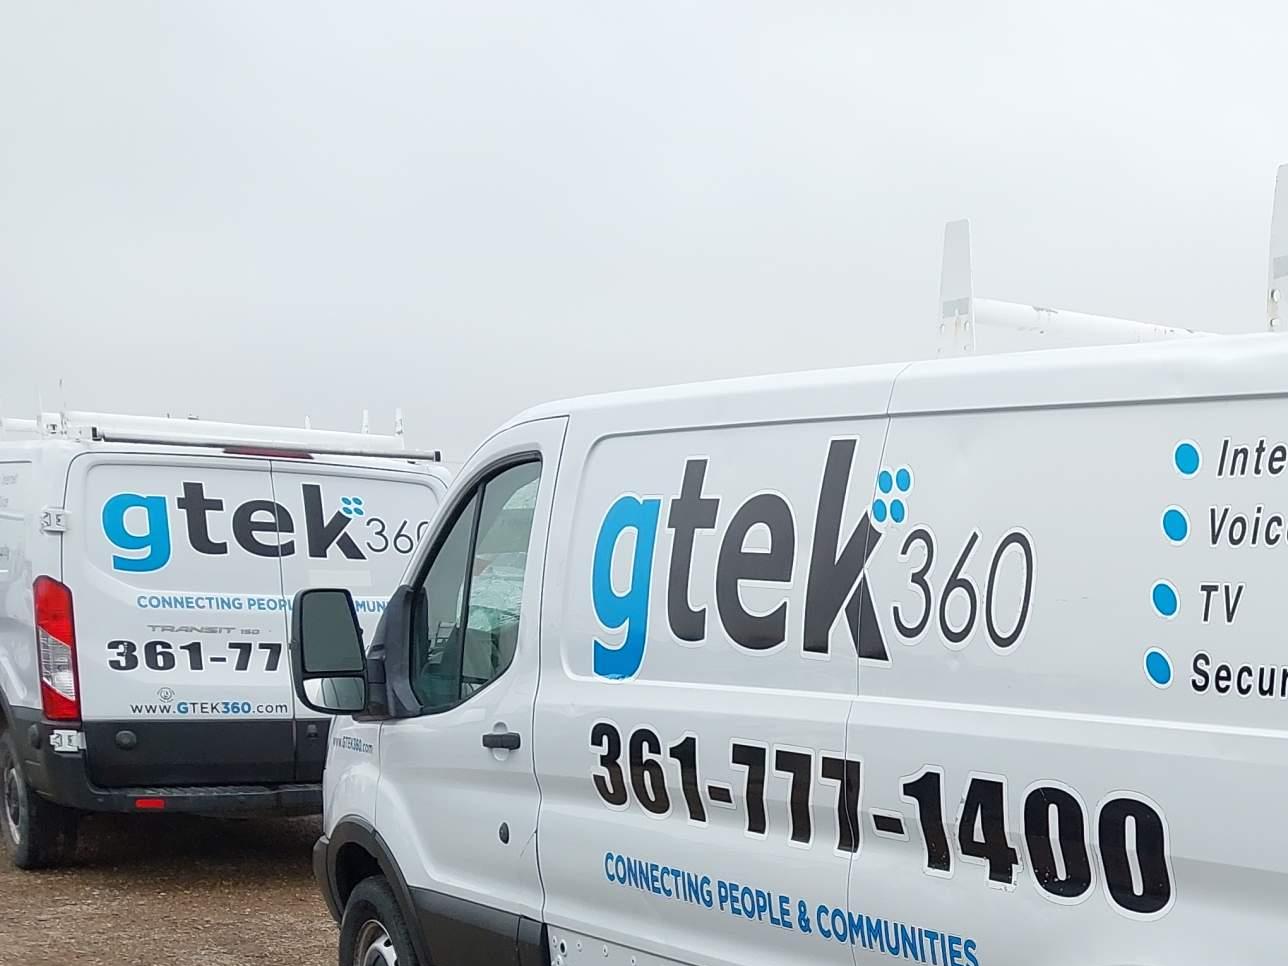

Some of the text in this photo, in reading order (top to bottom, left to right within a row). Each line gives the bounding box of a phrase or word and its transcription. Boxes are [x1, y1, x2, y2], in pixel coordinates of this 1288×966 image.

[138, 596, 293, 611] CONNECTING PEOPL
[1200, 585, 1243, 623] TV
[147, 624, 236, 634] TRANSIT
[131, 702, 288, 714] www.GTEK360.com
[591, 722, 1174, 914] 361-777-1400
[604, 852, 713, 908] CONNECTING
[718, 881, 793, 929] PEOPLE
[798, 900, 811, 933] &
